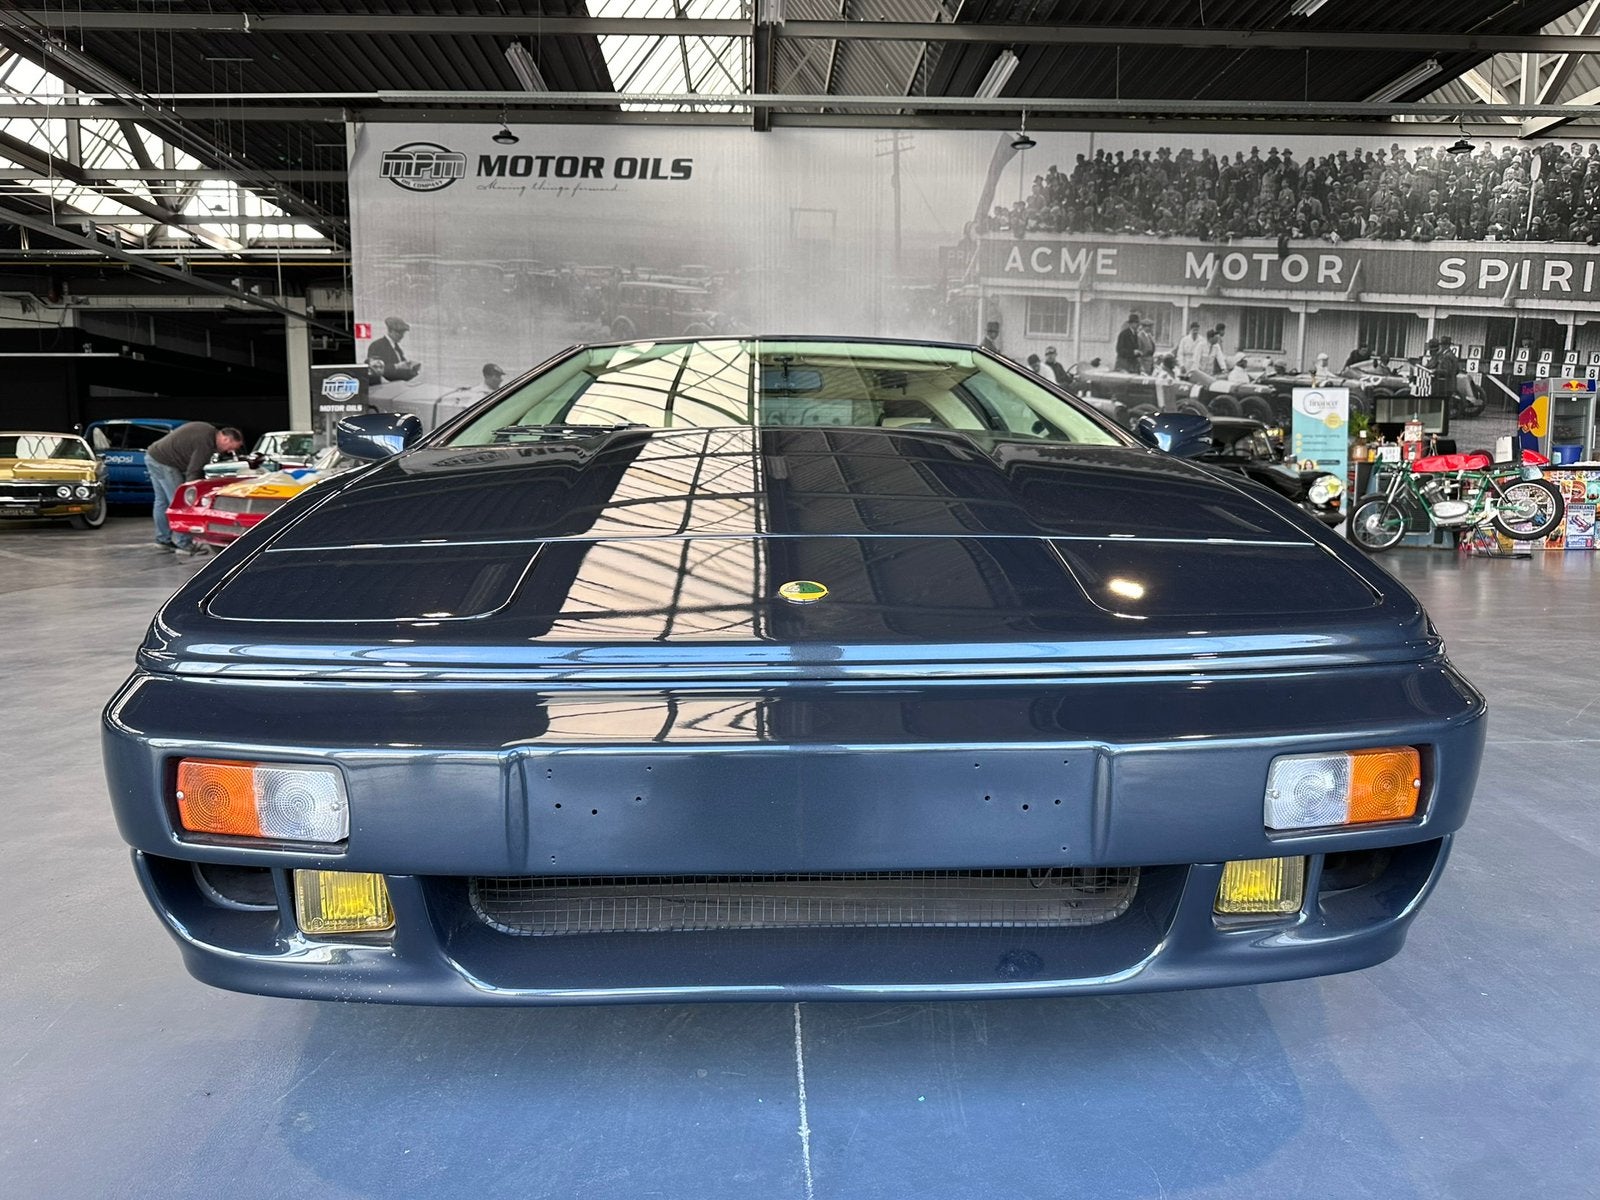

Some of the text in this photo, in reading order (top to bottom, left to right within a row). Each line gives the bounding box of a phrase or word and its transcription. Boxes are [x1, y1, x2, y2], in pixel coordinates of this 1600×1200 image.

[477, 155, 694, 180] MOTOR OILS
[1004, 246, 1596, 293] ACME MOTOR SPIRI
[1473, 348, 1479, 357] 0
[1497, 350, 1503, 358] 0
[1520, 350, 1527, 360] 0
[1543, 352, 1550, 361] 0
[1568, 353, 1575, 362] 0
[1470, 362, 1596, 378] 3 4 5 6 7 8
[320, 404, 363, 412] MOTOR OILS
